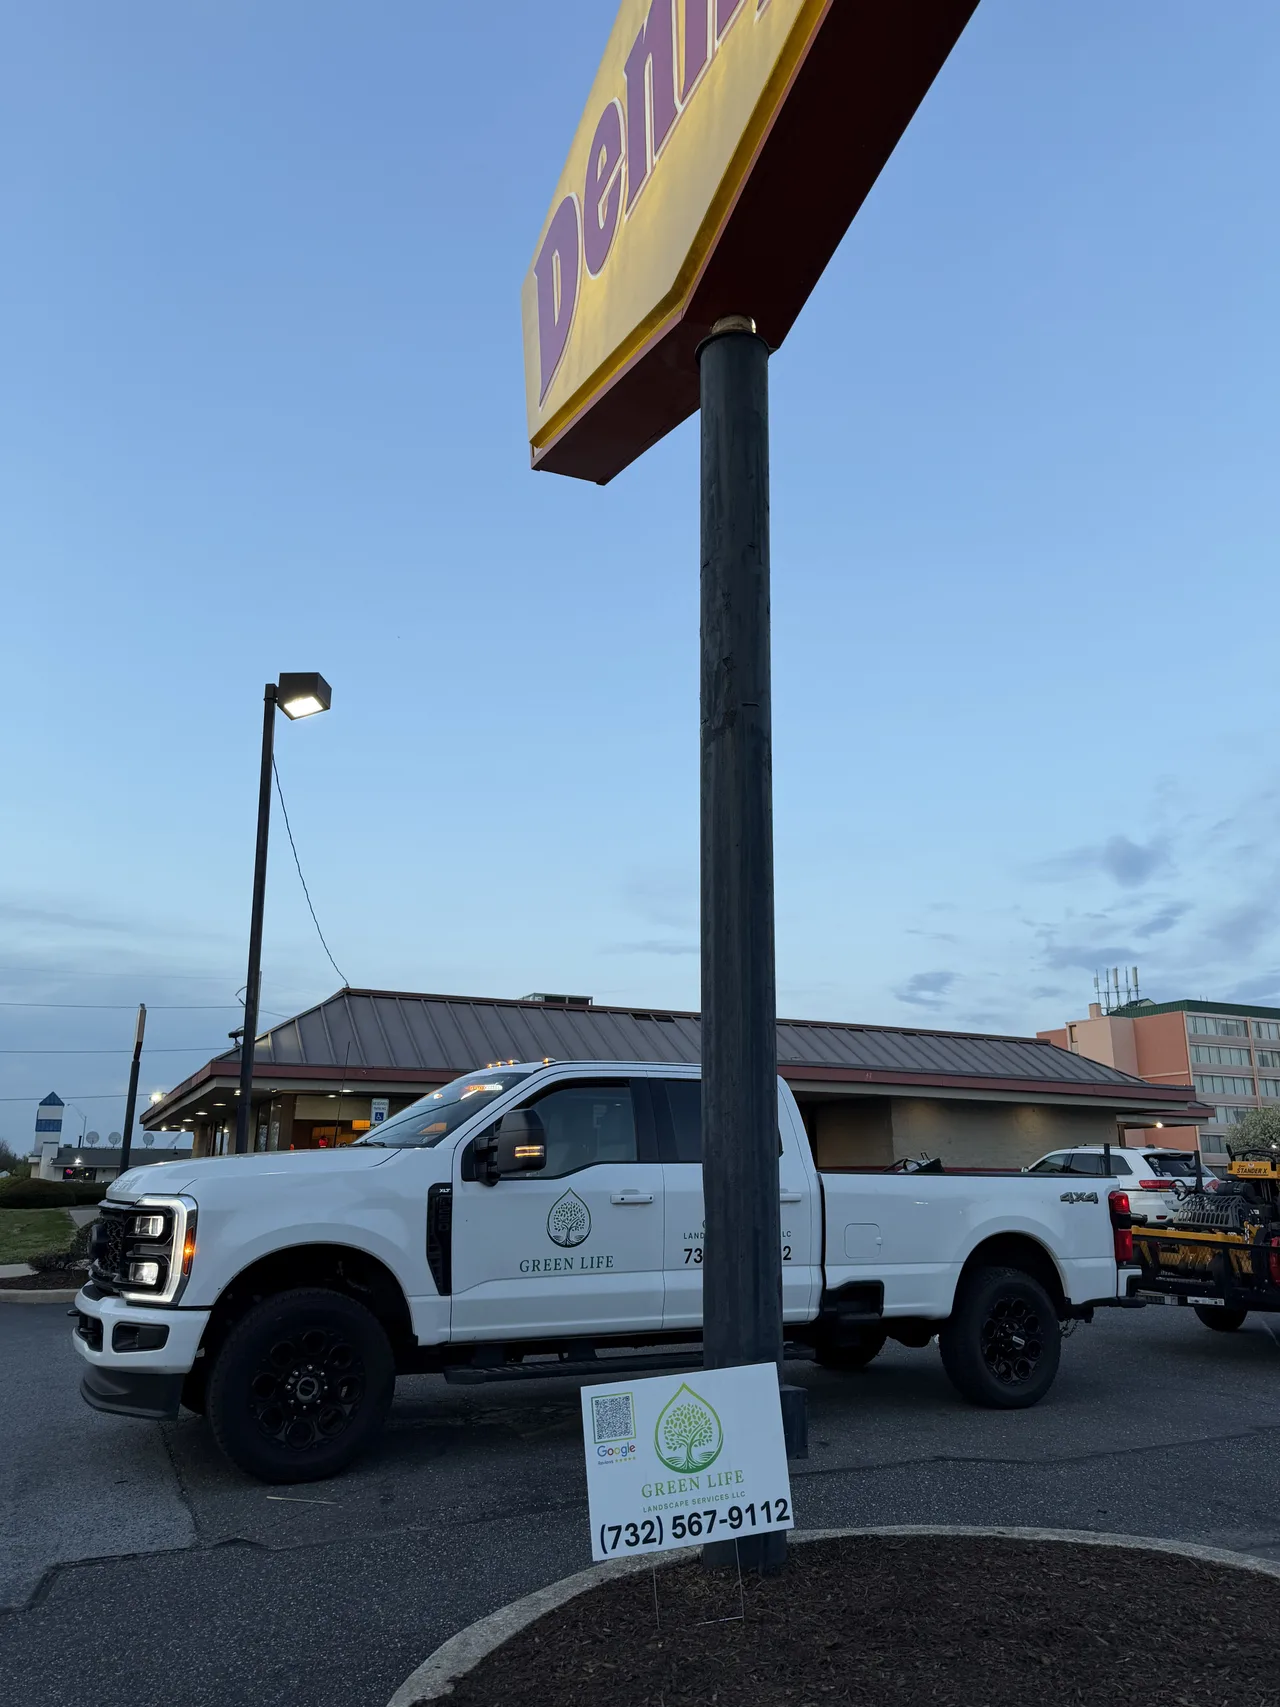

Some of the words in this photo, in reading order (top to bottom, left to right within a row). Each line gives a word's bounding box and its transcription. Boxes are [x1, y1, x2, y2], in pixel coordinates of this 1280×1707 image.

[519, 1256, 574, 1273] GREEN
[580, 1255, 615, 1269] LIFE
[597, 1441, 636, 1457] Google
[641, 1476, 700, 1498] GREEN
[707, 1469, 745, 1488] LIFE
[643, 1499, 690, 1512] LANDSCAPE
[691, 1493, 730, 1506] SERVICES
[731, 1490, 746, 1499] LLC
[600, 1515, 664, 1554] (732)
[671, 1498, 790, 1539] 567-9112
